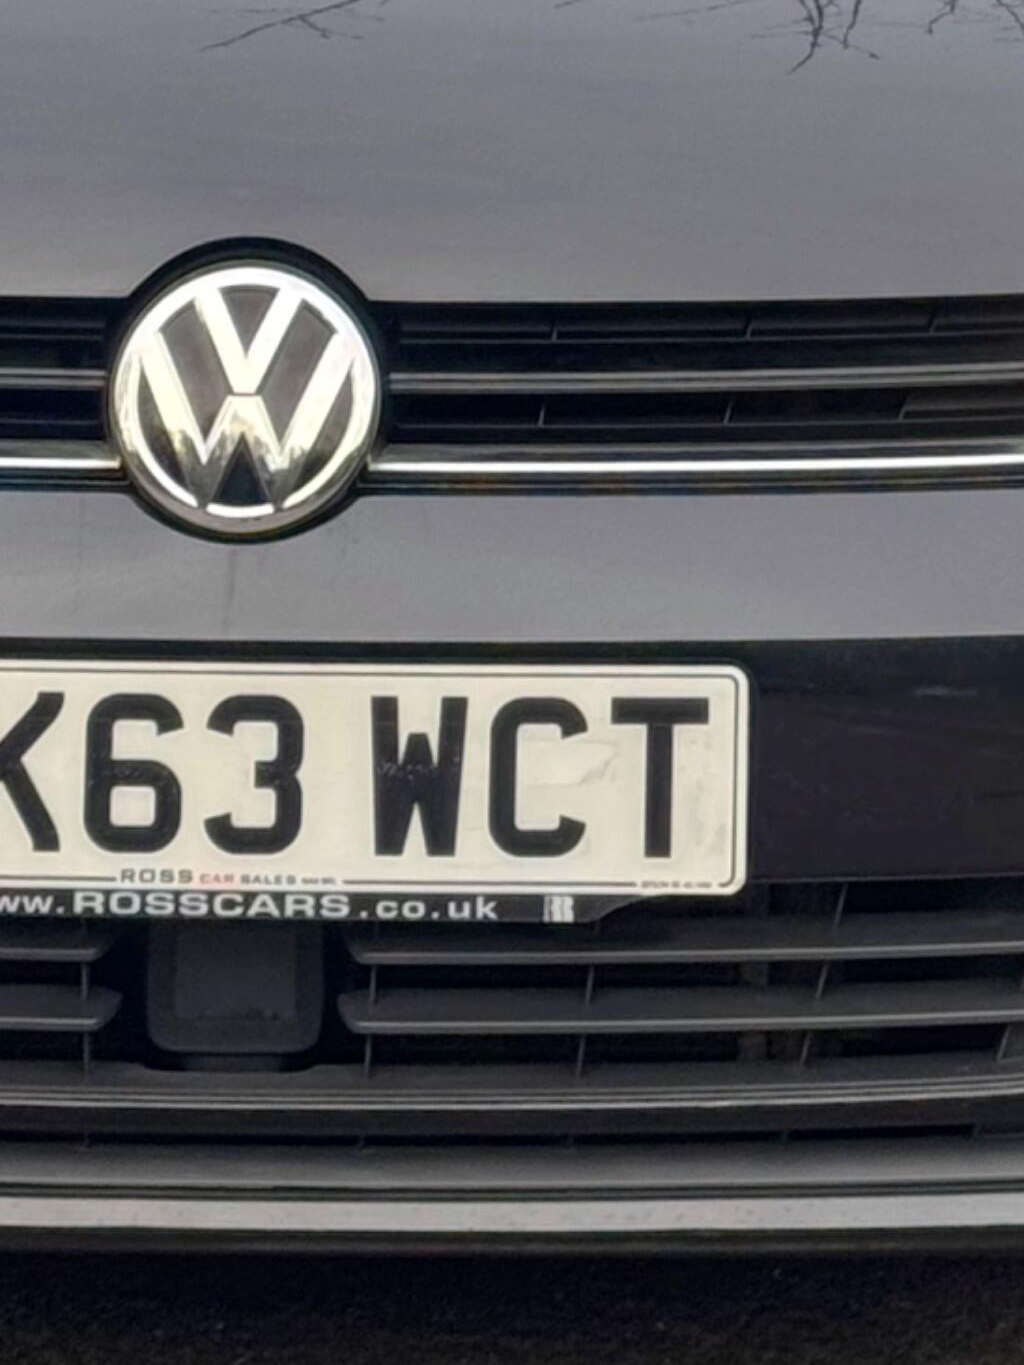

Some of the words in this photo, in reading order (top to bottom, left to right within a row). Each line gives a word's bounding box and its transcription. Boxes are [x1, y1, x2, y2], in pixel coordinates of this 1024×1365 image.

[0, 690, 305, 855] K63
[371, 695, 710, 858] WCT
[120, 867, 194, 884] ROSS
[200, 873, 235, 884] CAR
[240, 873, 297, 885] SALES
